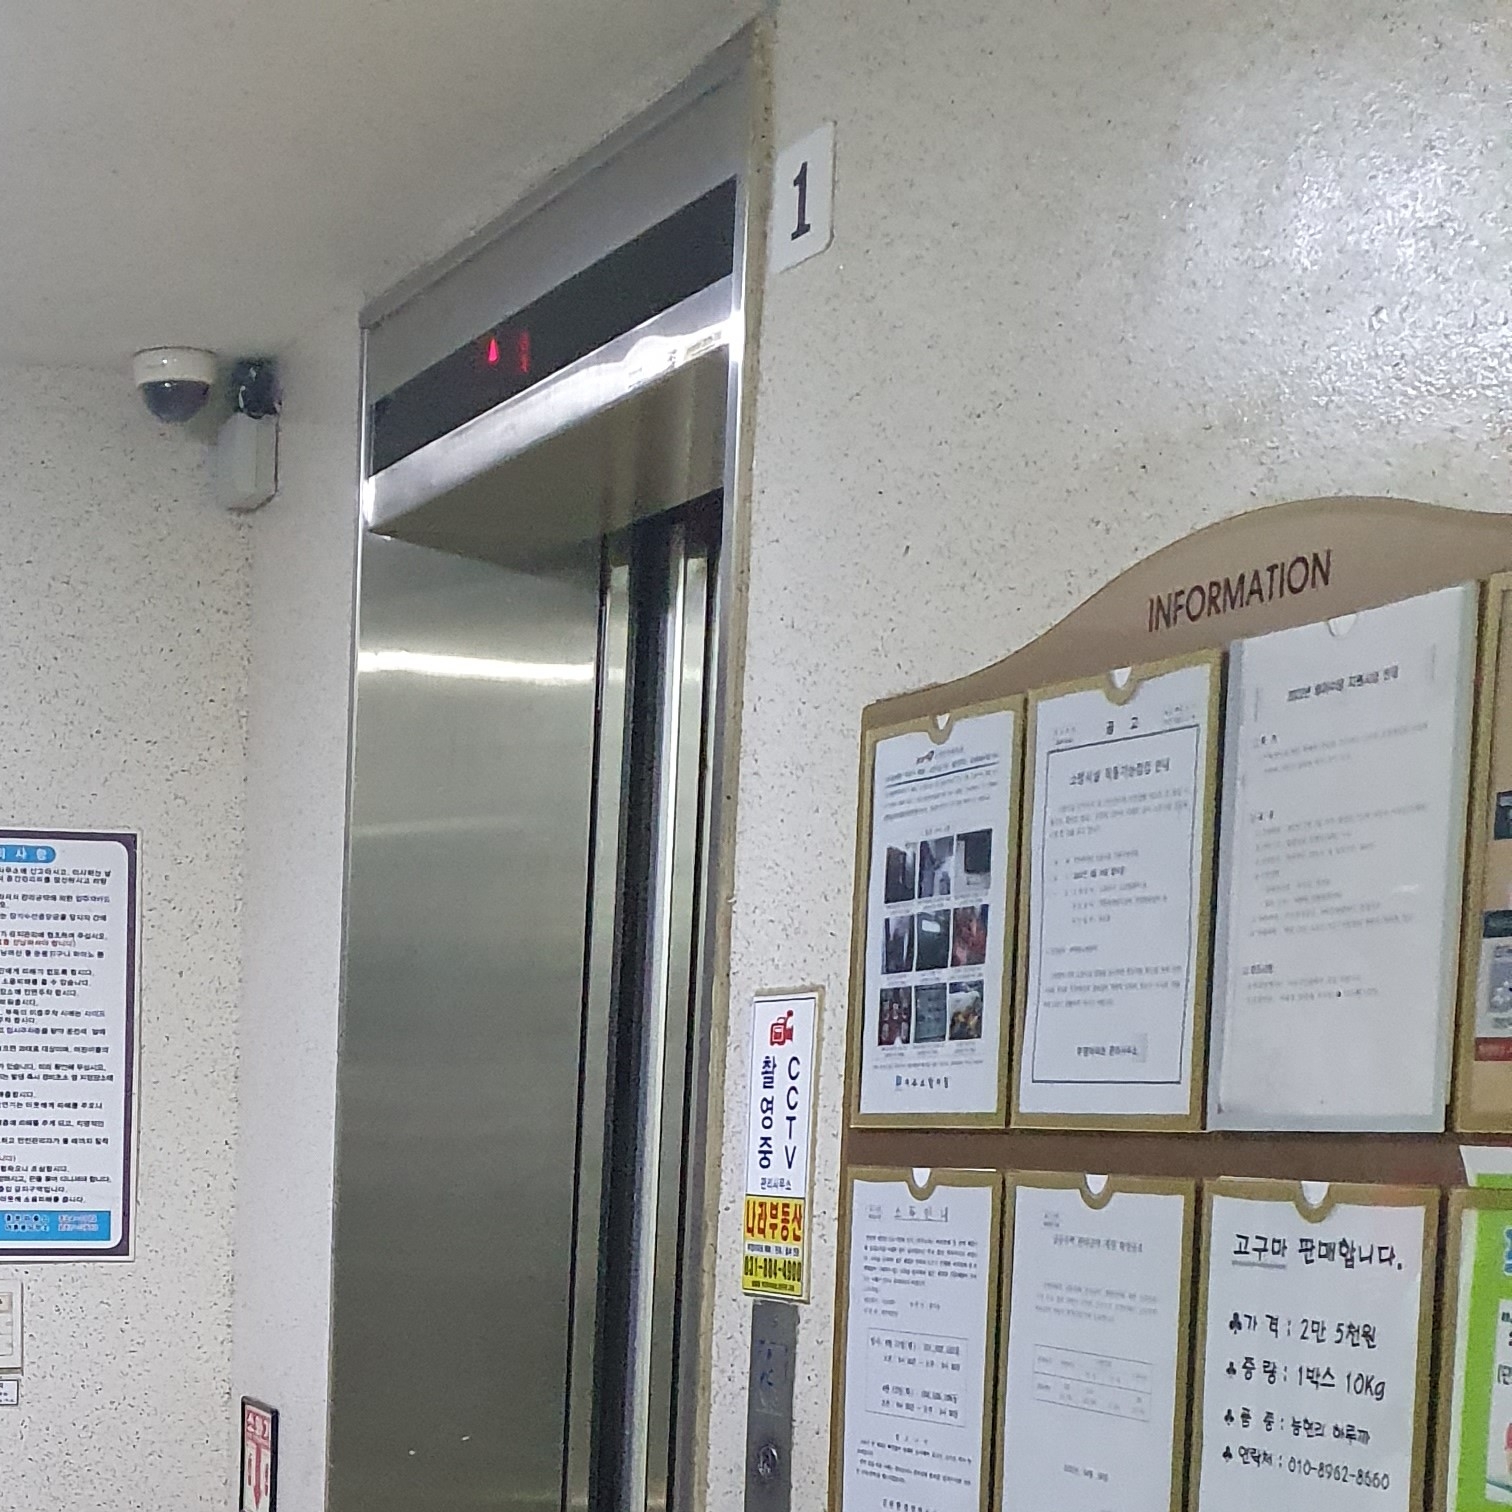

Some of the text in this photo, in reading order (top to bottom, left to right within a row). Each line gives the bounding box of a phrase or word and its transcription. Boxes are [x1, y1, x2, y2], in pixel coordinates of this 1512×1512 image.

[791, 161, 810, 240] 1
[1148, 549, 1332, 632] INFORMATION
[758, 1055, 778, 1169] 촬영중
[785, 1056, 800, 1169] CCTV
[1233, 1234, 1402, 1270] 고구마 판매합니다.
[1300, 1318, 1327, 1343] 2만
[1334, 1321, 1377, 1348] 5천원
[1298, 1365, 1336, 1390] 1박스
